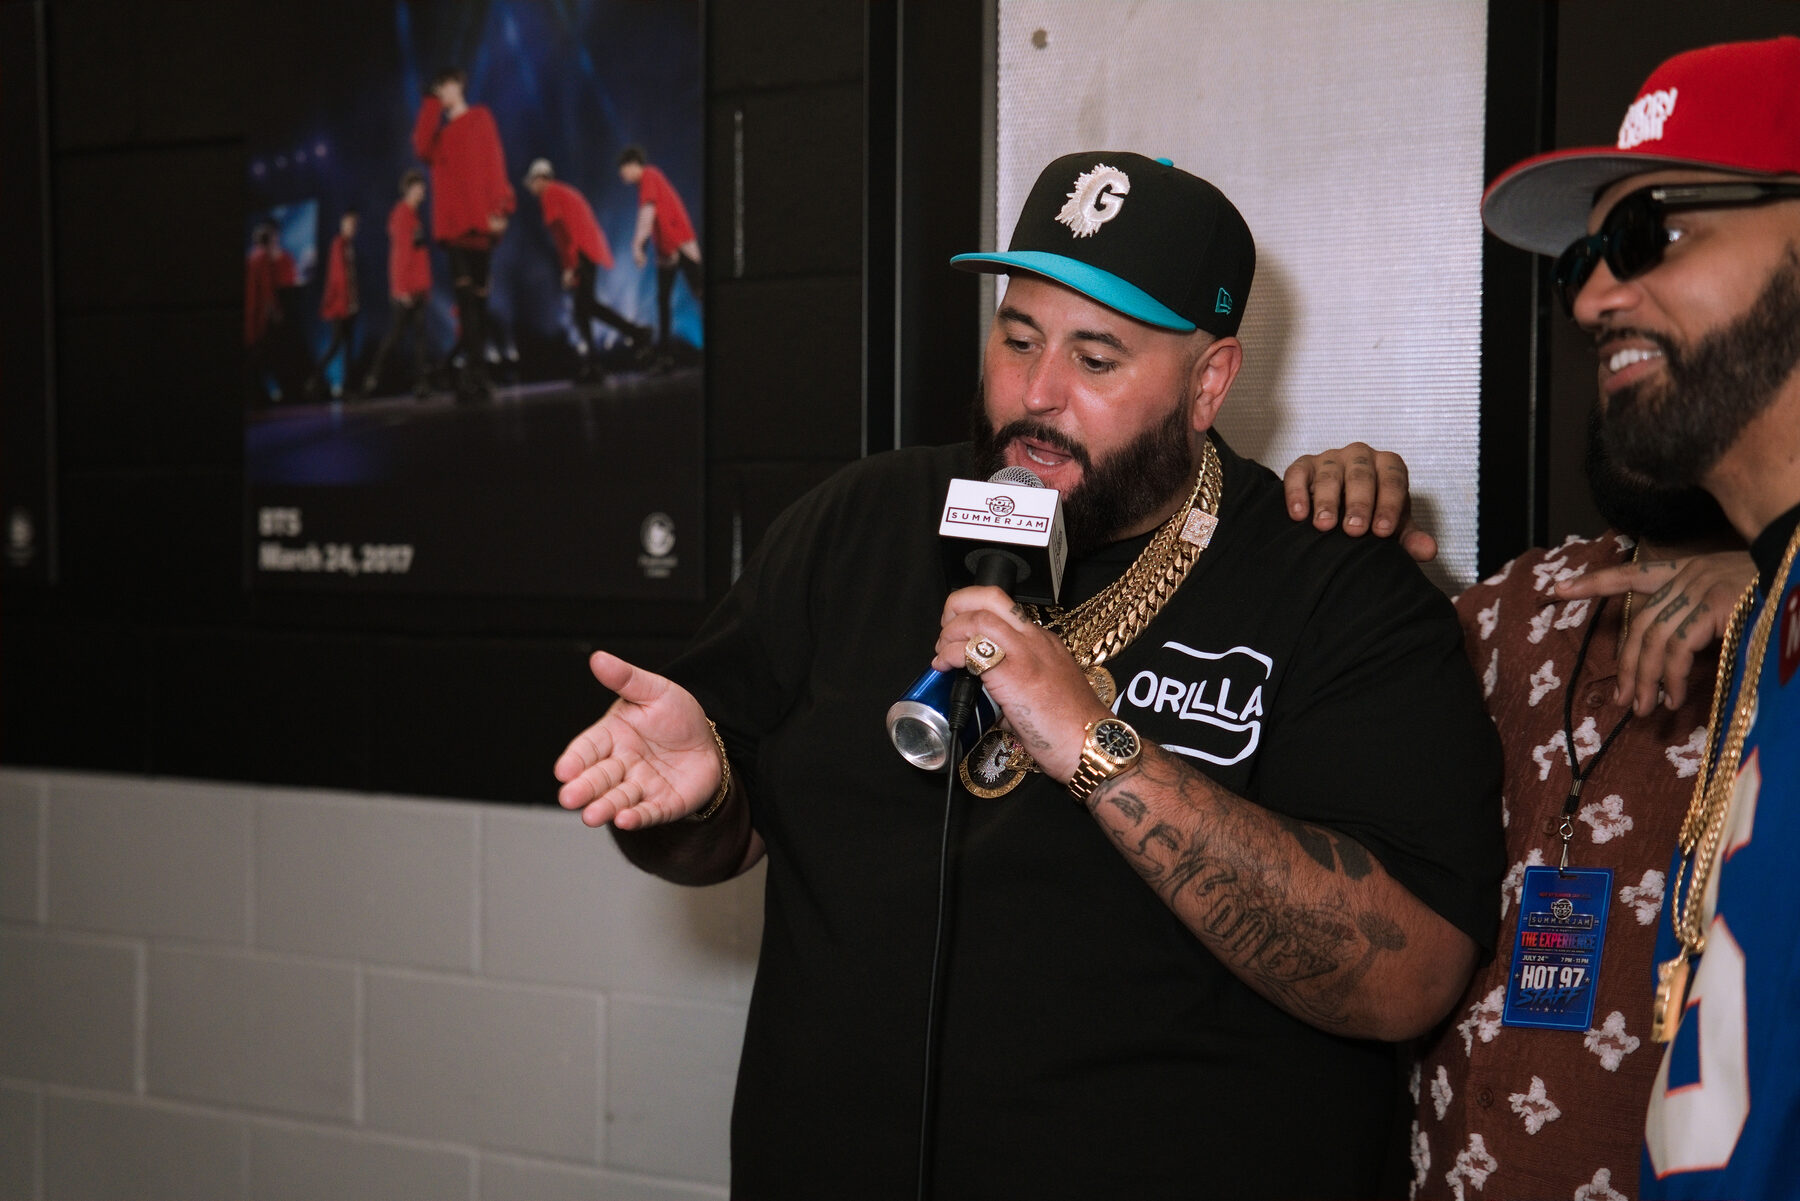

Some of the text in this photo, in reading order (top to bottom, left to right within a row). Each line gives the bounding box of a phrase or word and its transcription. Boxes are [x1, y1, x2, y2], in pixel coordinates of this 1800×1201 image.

[259, 507, 301, 536] BTS
[951, 512, 1044, 528] SUMMER JAM
[259, 543, 414, 576] March 24, 2017
[1531, 917, 1570, 925] SUMMER
[1572, 918, 1591, 926] JAM
[1521, 932, 1597, 949] THE EXPERIENCE
[1521, 965, 1585, 990] HOT 97
[1514, 986, 1582, 1005] STAFF
